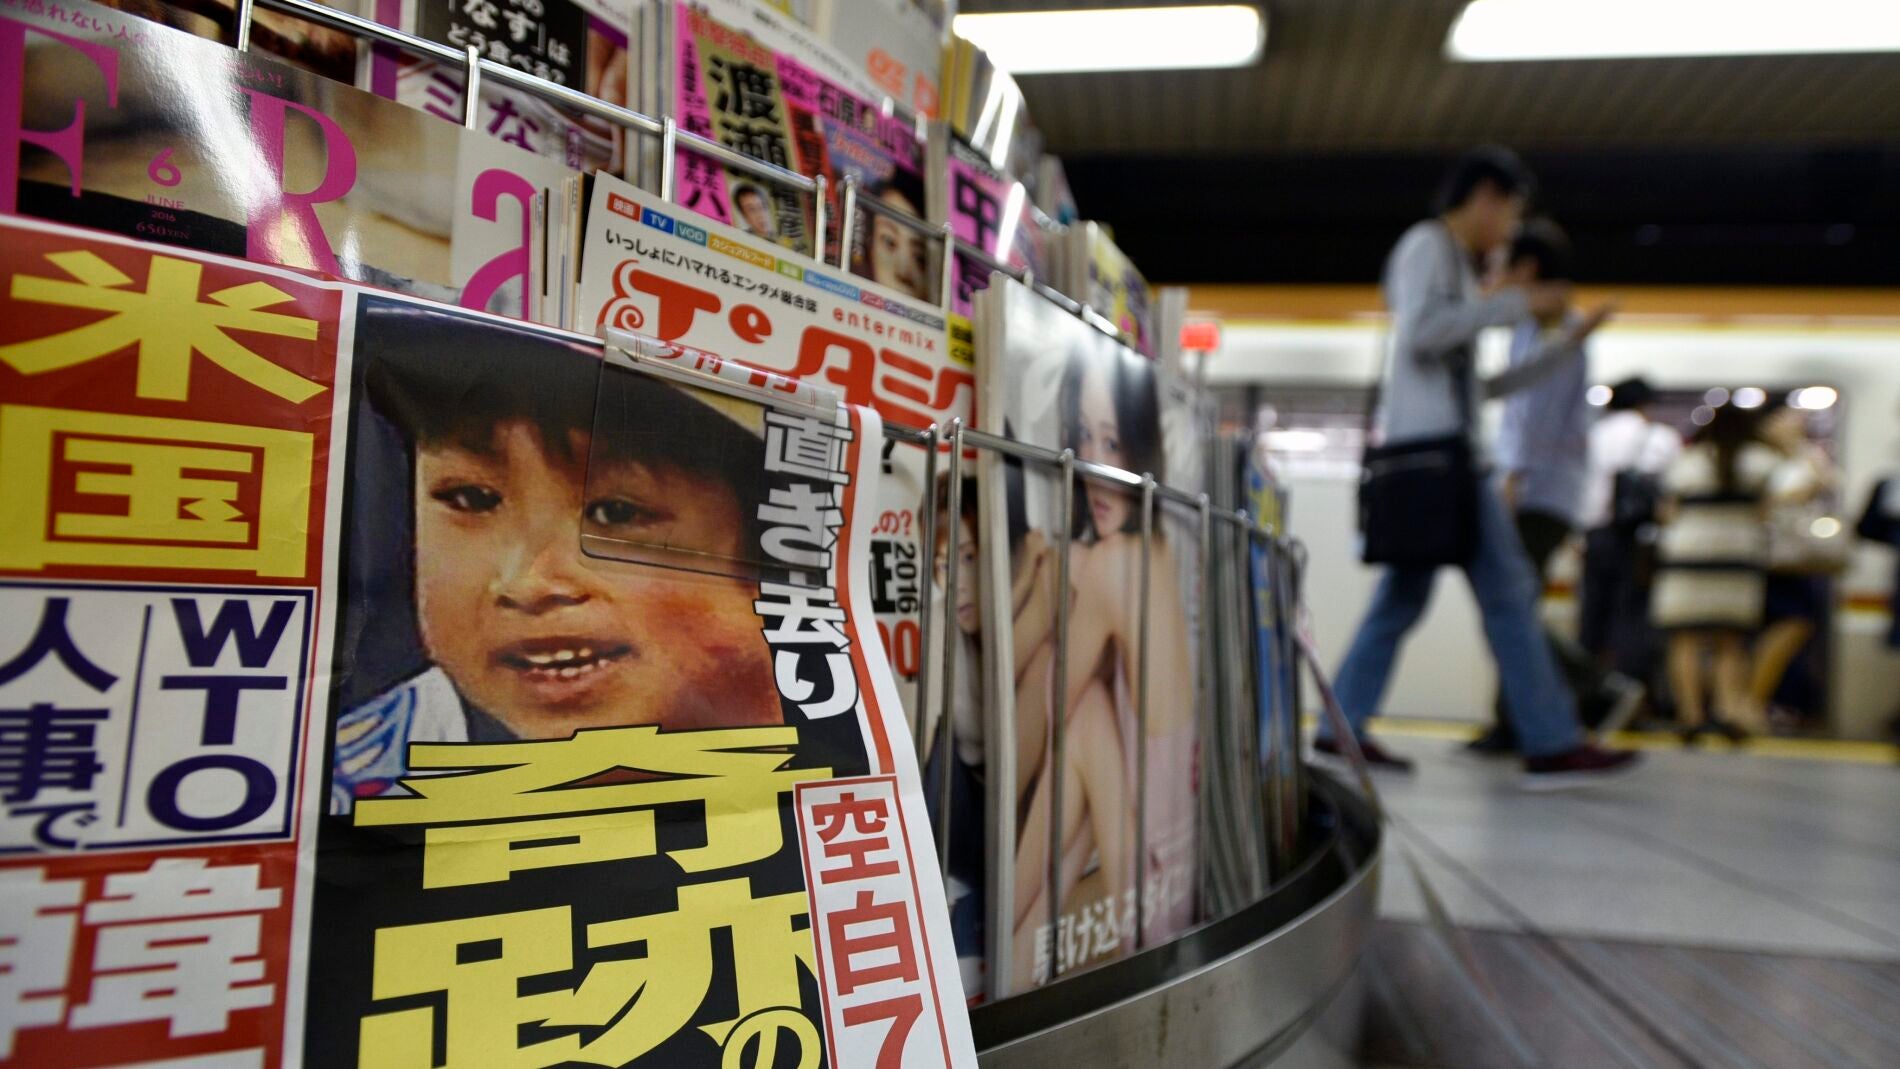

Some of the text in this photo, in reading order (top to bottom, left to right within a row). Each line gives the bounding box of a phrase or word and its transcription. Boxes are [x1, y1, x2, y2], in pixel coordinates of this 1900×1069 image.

[146, 146, 183, 188] 6
[143, 193, 186, 211] JUNE
[151, 209, 177, 222] 2016
[649, 214, 668, 229] TV
[677, 224, 704, 243] VOD
[832, 306, 937, 352] entermix
[0, 250, 329, 578] 米国
[895, 542, 919, 614] 2016
[0, 597, 119, 853] 人事で
[146, 598, 297, 833] WTO
